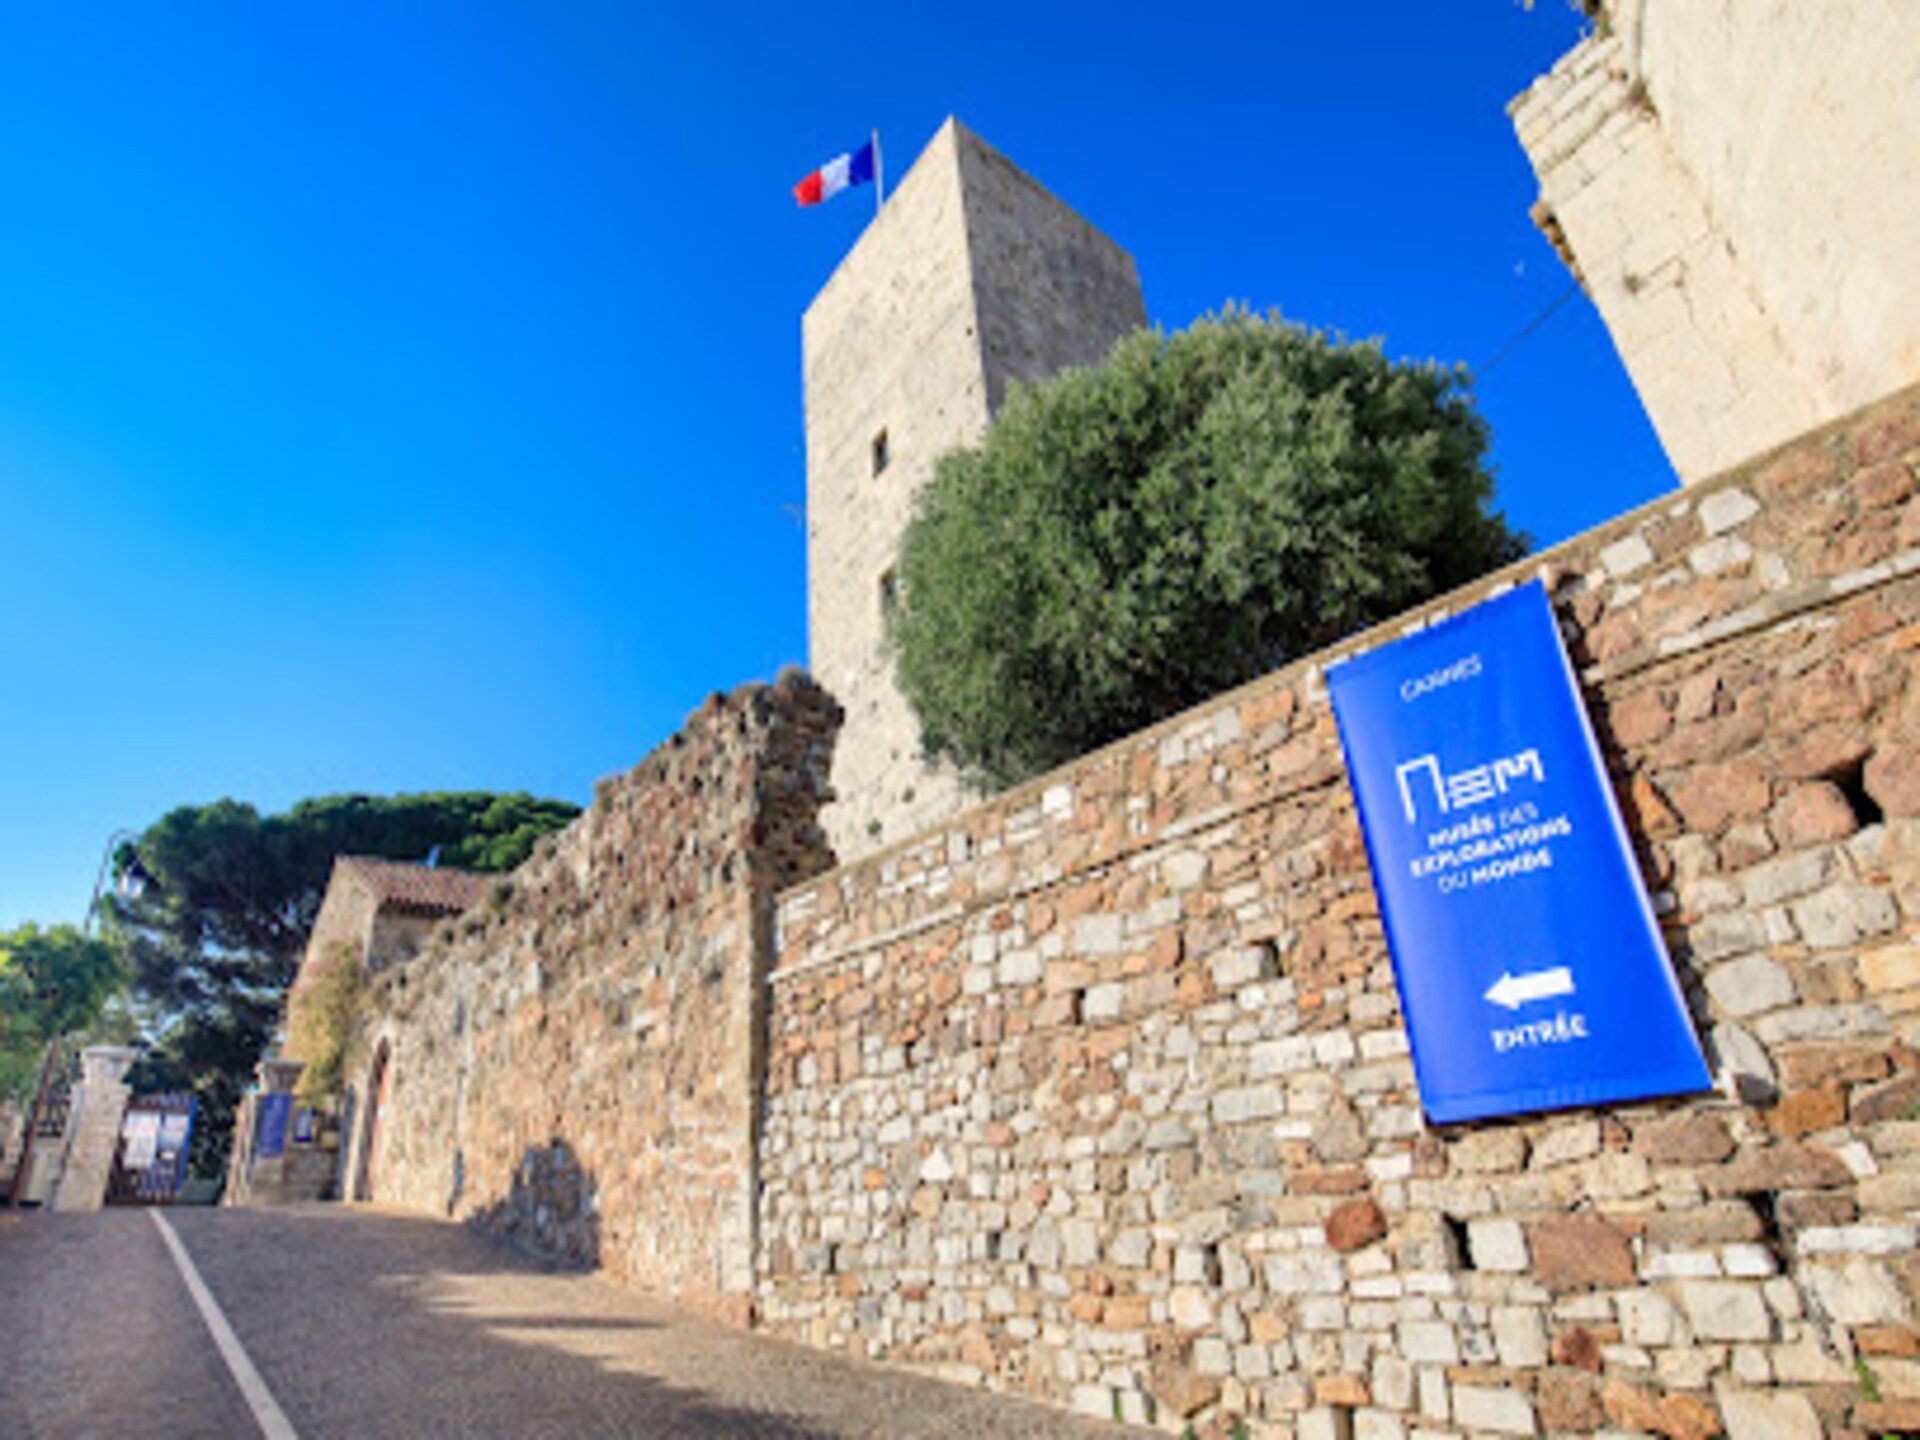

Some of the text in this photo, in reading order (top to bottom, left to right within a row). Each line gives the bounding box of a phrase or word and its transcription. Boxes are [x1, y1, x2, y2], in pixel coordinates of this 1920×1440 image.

[1400, 653, 1482, 701] CANNES
[1499, 801, 1538, 829] DES
[1409, 815, 1572, 877] EXPLORATIONS
[1438, 847, 1552, 893] DU MONDE
[1491, 1012, 1589, 1053] ENTRÉE
